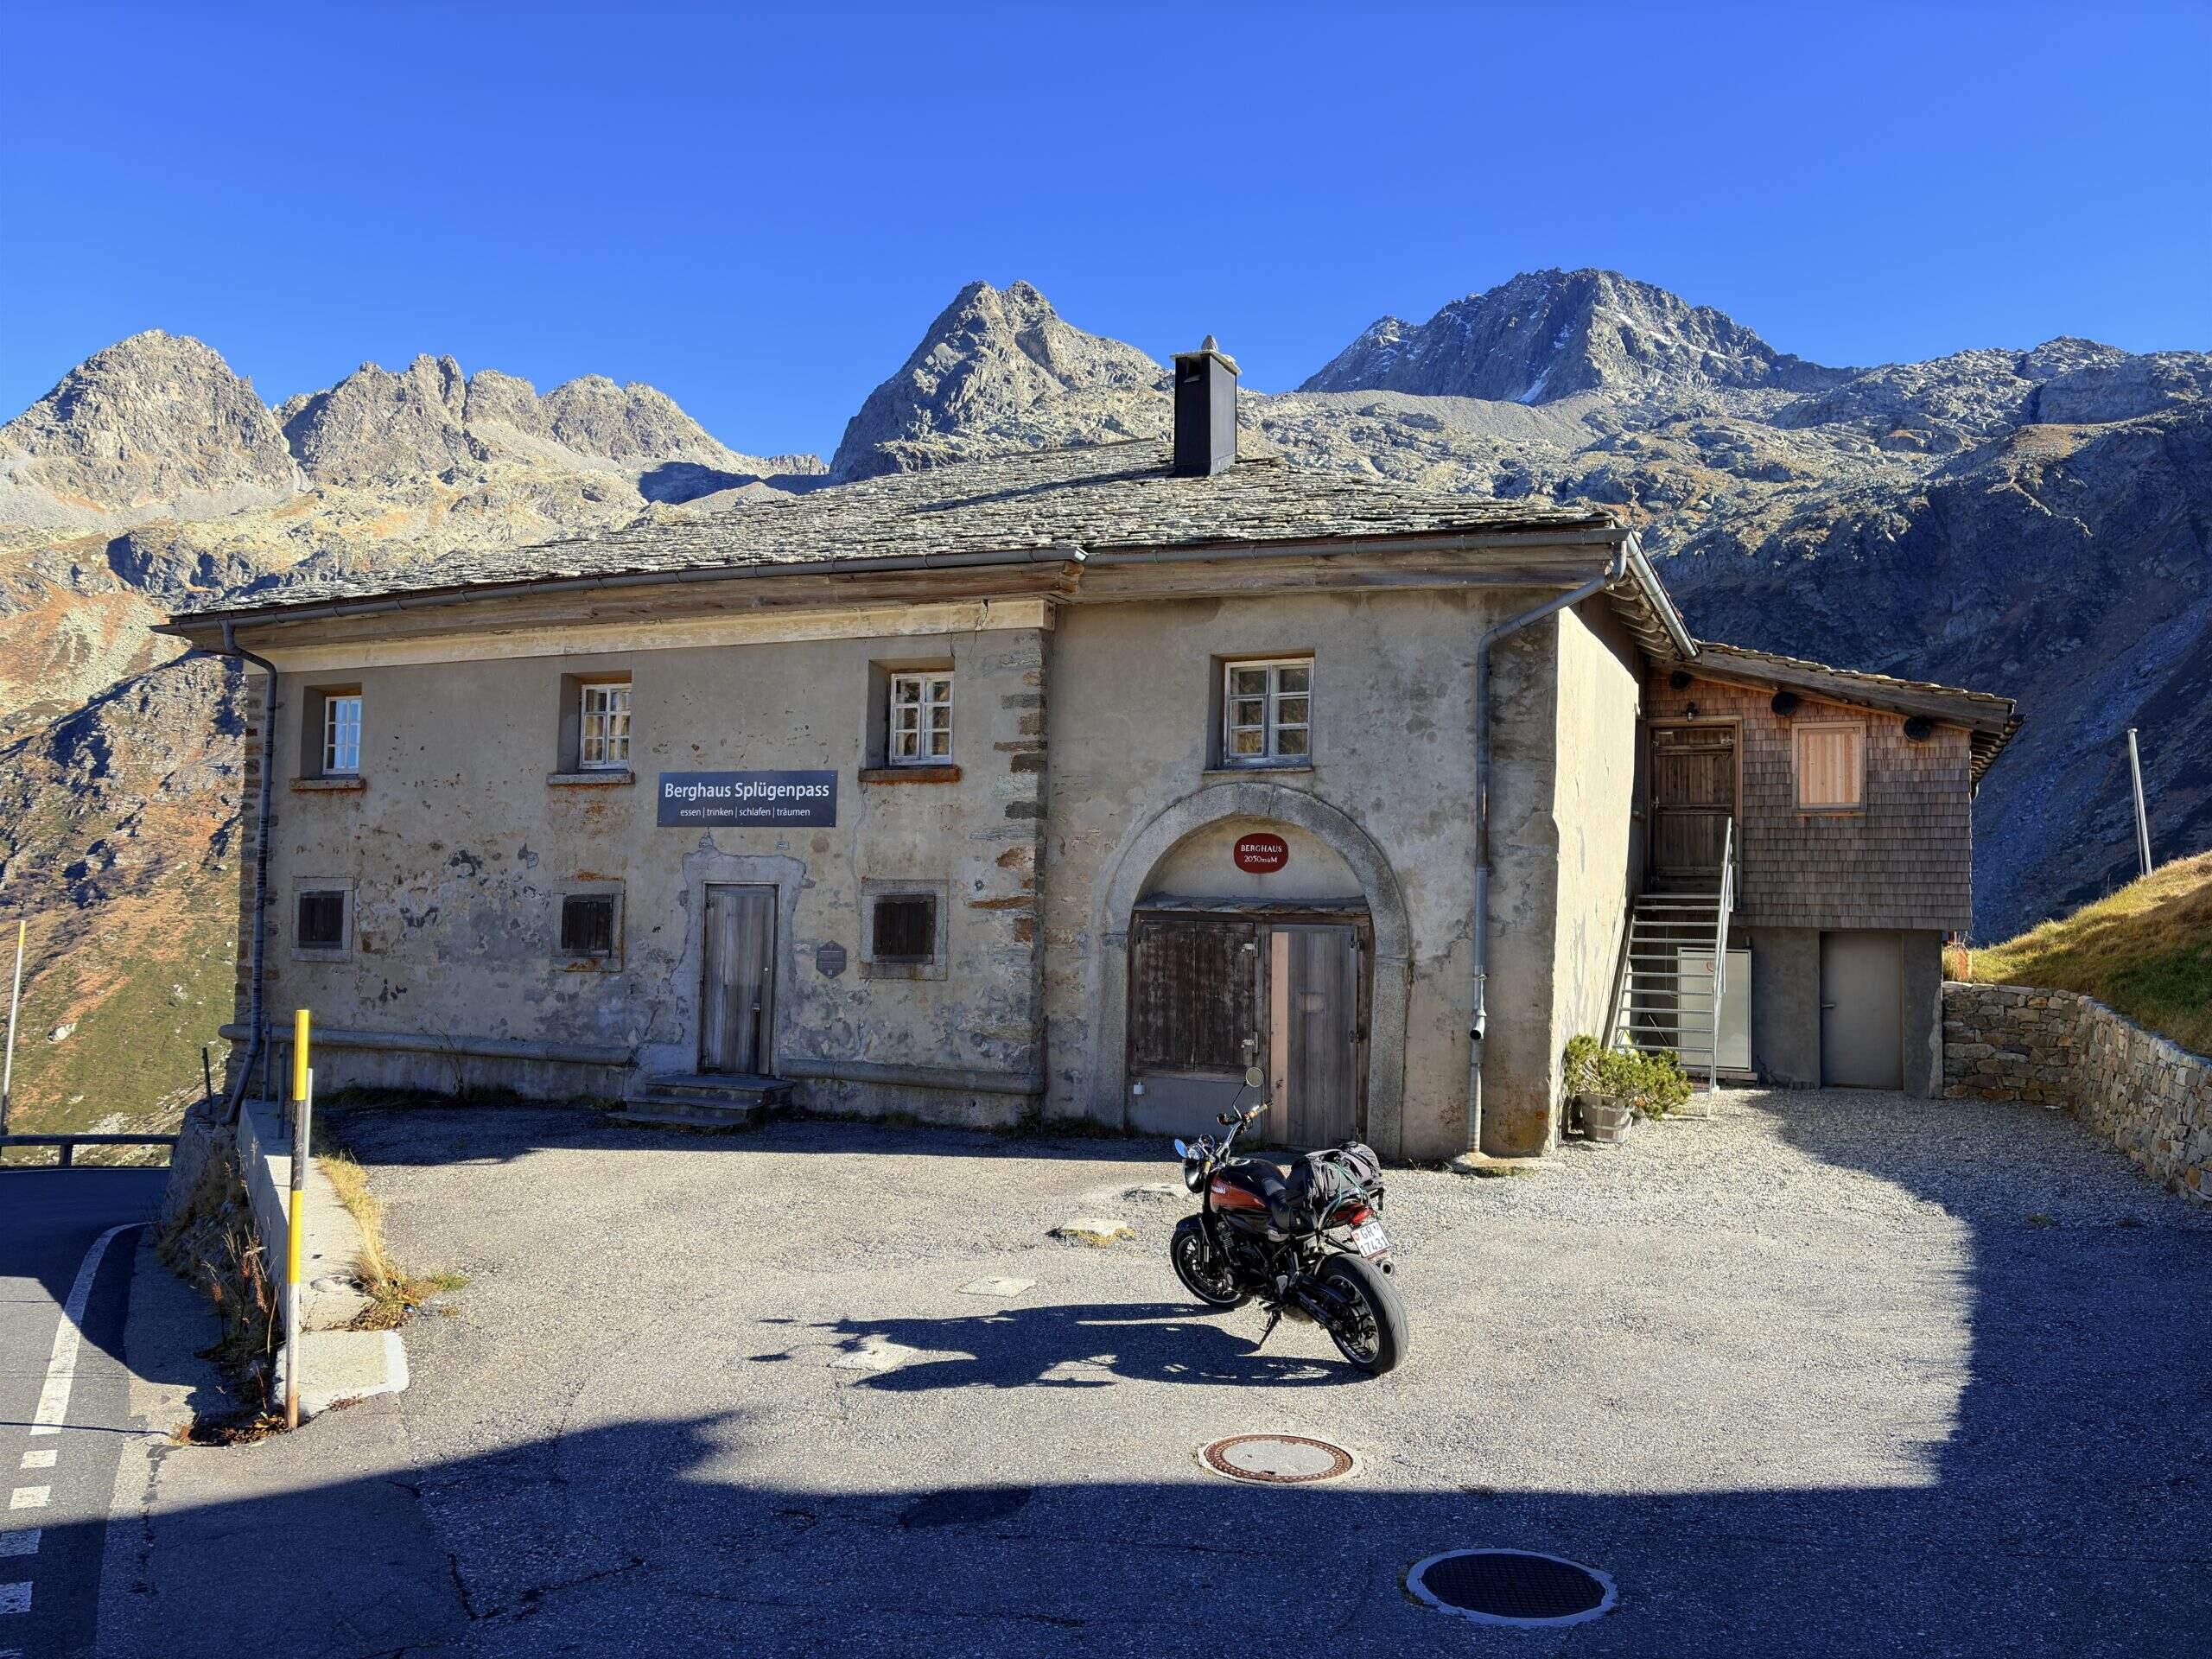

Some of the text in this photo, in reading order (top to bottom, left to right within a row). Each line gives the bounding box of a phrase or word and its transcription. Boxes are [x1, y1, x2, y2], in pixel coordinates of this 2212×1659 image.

[664, 781, 830, 801] Berghaus Splügenpass
[707, 807, 734, 817] trinken
[739, 807, 771, 817] schlafen
[777, 807, 810, 817] träumen
[1241, 844, 1282, 853] BERGHAUS
[1360, 1226, 1375, 1239] GR
[1361, 1236, 1388, 1255] 17431
